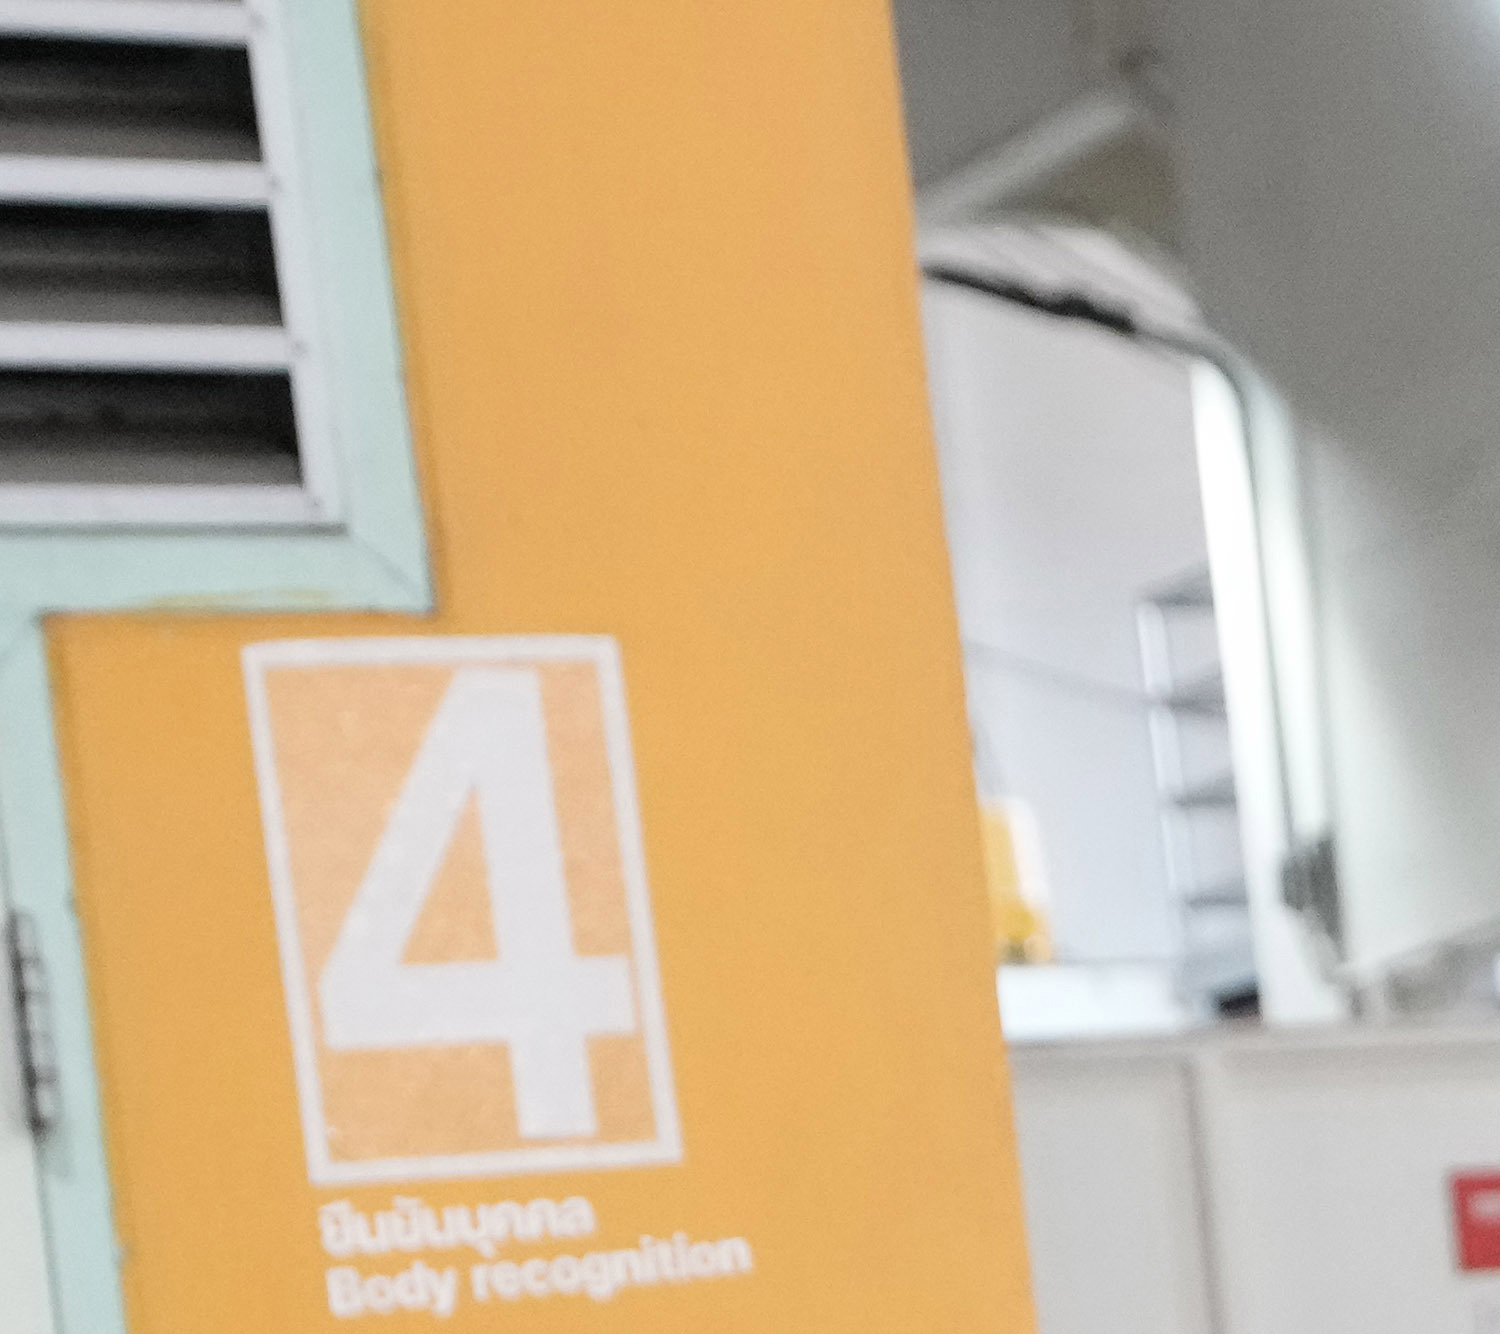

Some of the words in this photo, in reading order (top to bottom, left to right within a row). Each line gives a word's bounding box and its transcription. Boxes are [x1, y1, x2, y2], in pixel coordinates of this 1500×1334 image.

[317, 666, 636, 1139] 4
[326, 1261, 457, 1317] Body
[471, 1232, 753, 1301] recognition
